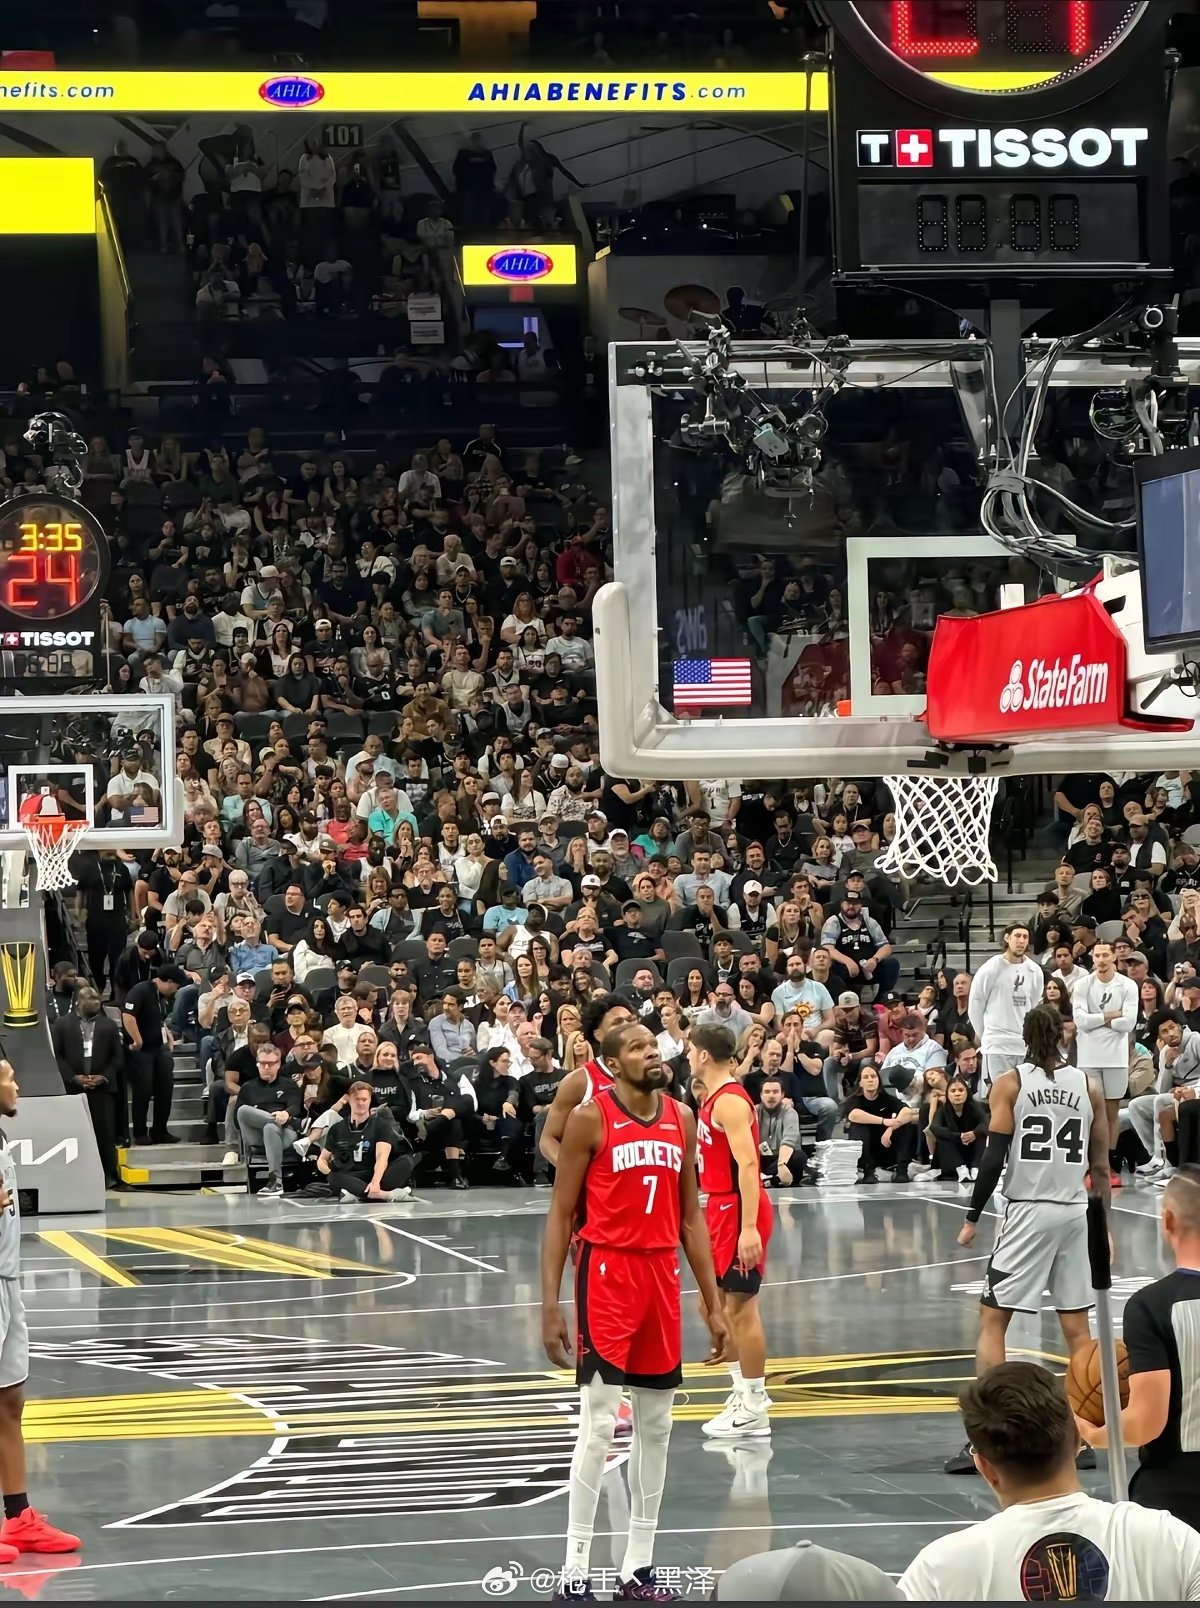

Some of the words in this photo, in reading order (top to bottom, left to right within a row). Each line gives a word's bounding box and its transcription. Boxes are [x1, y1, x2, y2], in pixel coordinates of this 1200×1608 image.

[270, 84, 311, 98] AHIA
[325, 125, 359, 145] 101
[939, 128, 1148, 168] TISSOT
[500, 258, 540, 271] AHIA
[20, 523, 82, 551] 3:35
[8, 554, 77, 607] 24
[20, 631, 95, 647] TISSOT
[1027, 1088, 1081, 1112] VASSELL
[1019, 1113, 1085, 1165] 24
[612, 1140, 683, 1173] ROCKETS
[642, 1175, 659, 1215] 7
